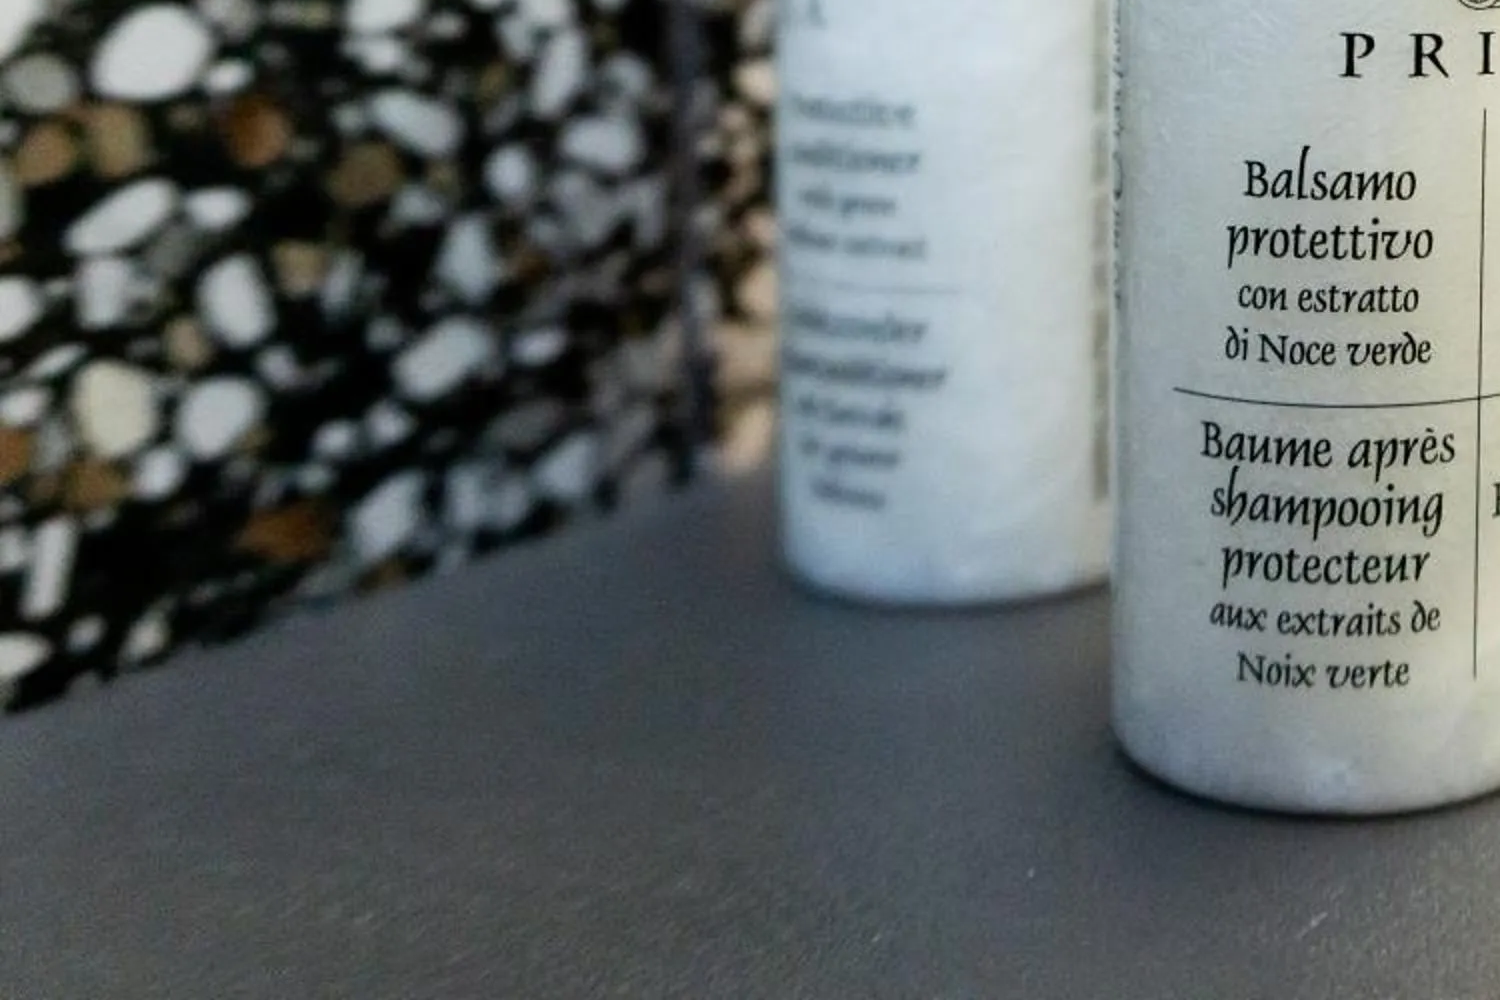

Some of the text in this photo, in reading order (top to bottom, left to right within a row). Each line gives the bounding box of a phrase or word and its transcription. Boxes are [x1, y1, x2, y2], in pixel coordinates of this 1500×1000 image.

[1242, 144, 1417, 202] Balsamo
[1225, 216, 1435, 270] protettivo
[1236, 283, 1420, 314] con estratto
[1224, 325, 1433, 368] di Noce verde
[1199, 420, 1457, 485] Baume après
[1210, 464, 1445, 543] shampooing
[1221, 545, 1431, 591] protecteur
[1209, 599, 1441, 638] aux extraits de
[1237, 651, 1410, 689] Noix verte
